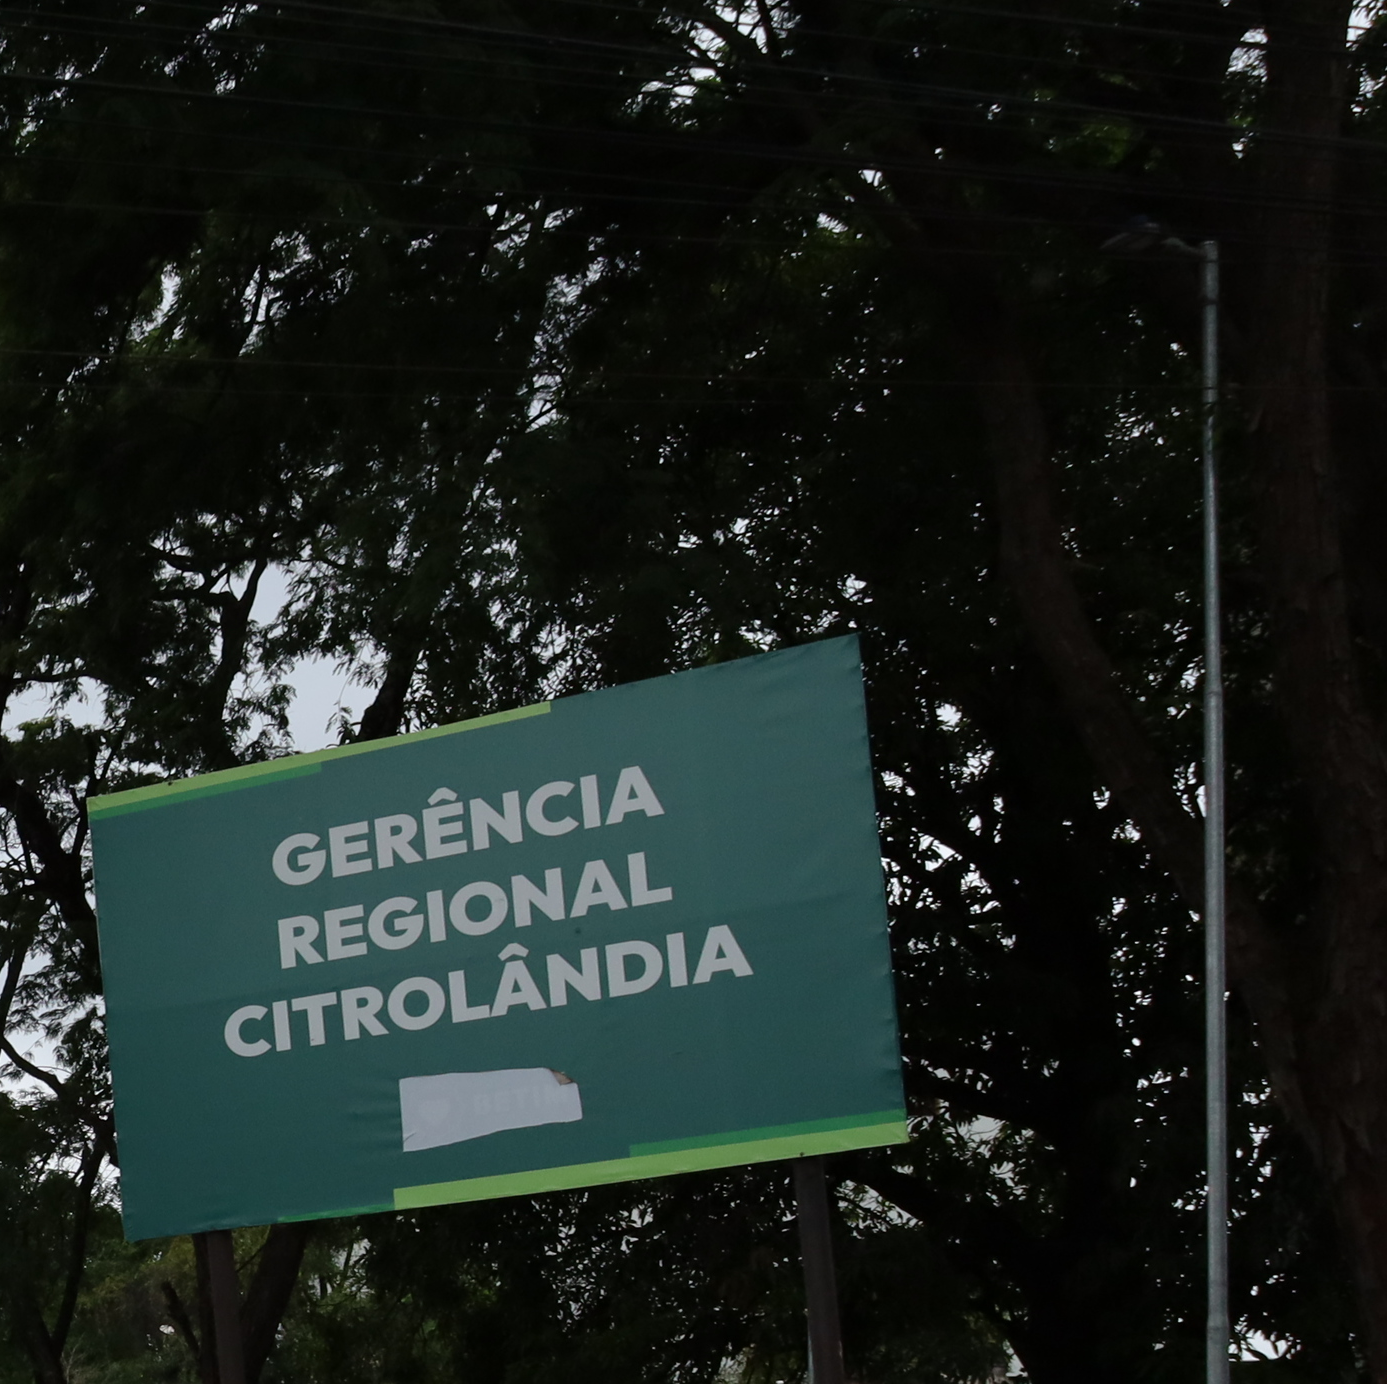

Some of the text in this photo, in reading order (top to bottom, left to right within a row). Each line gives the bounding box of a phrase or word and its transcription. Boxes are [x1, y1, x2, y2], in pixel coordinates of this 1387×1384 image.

[272, 765, 665, 886] GERÊNCIA
[277, 851, 673, 969] REGIONAL
[224, 924, 754, 1057] CITROLÂNDIA
